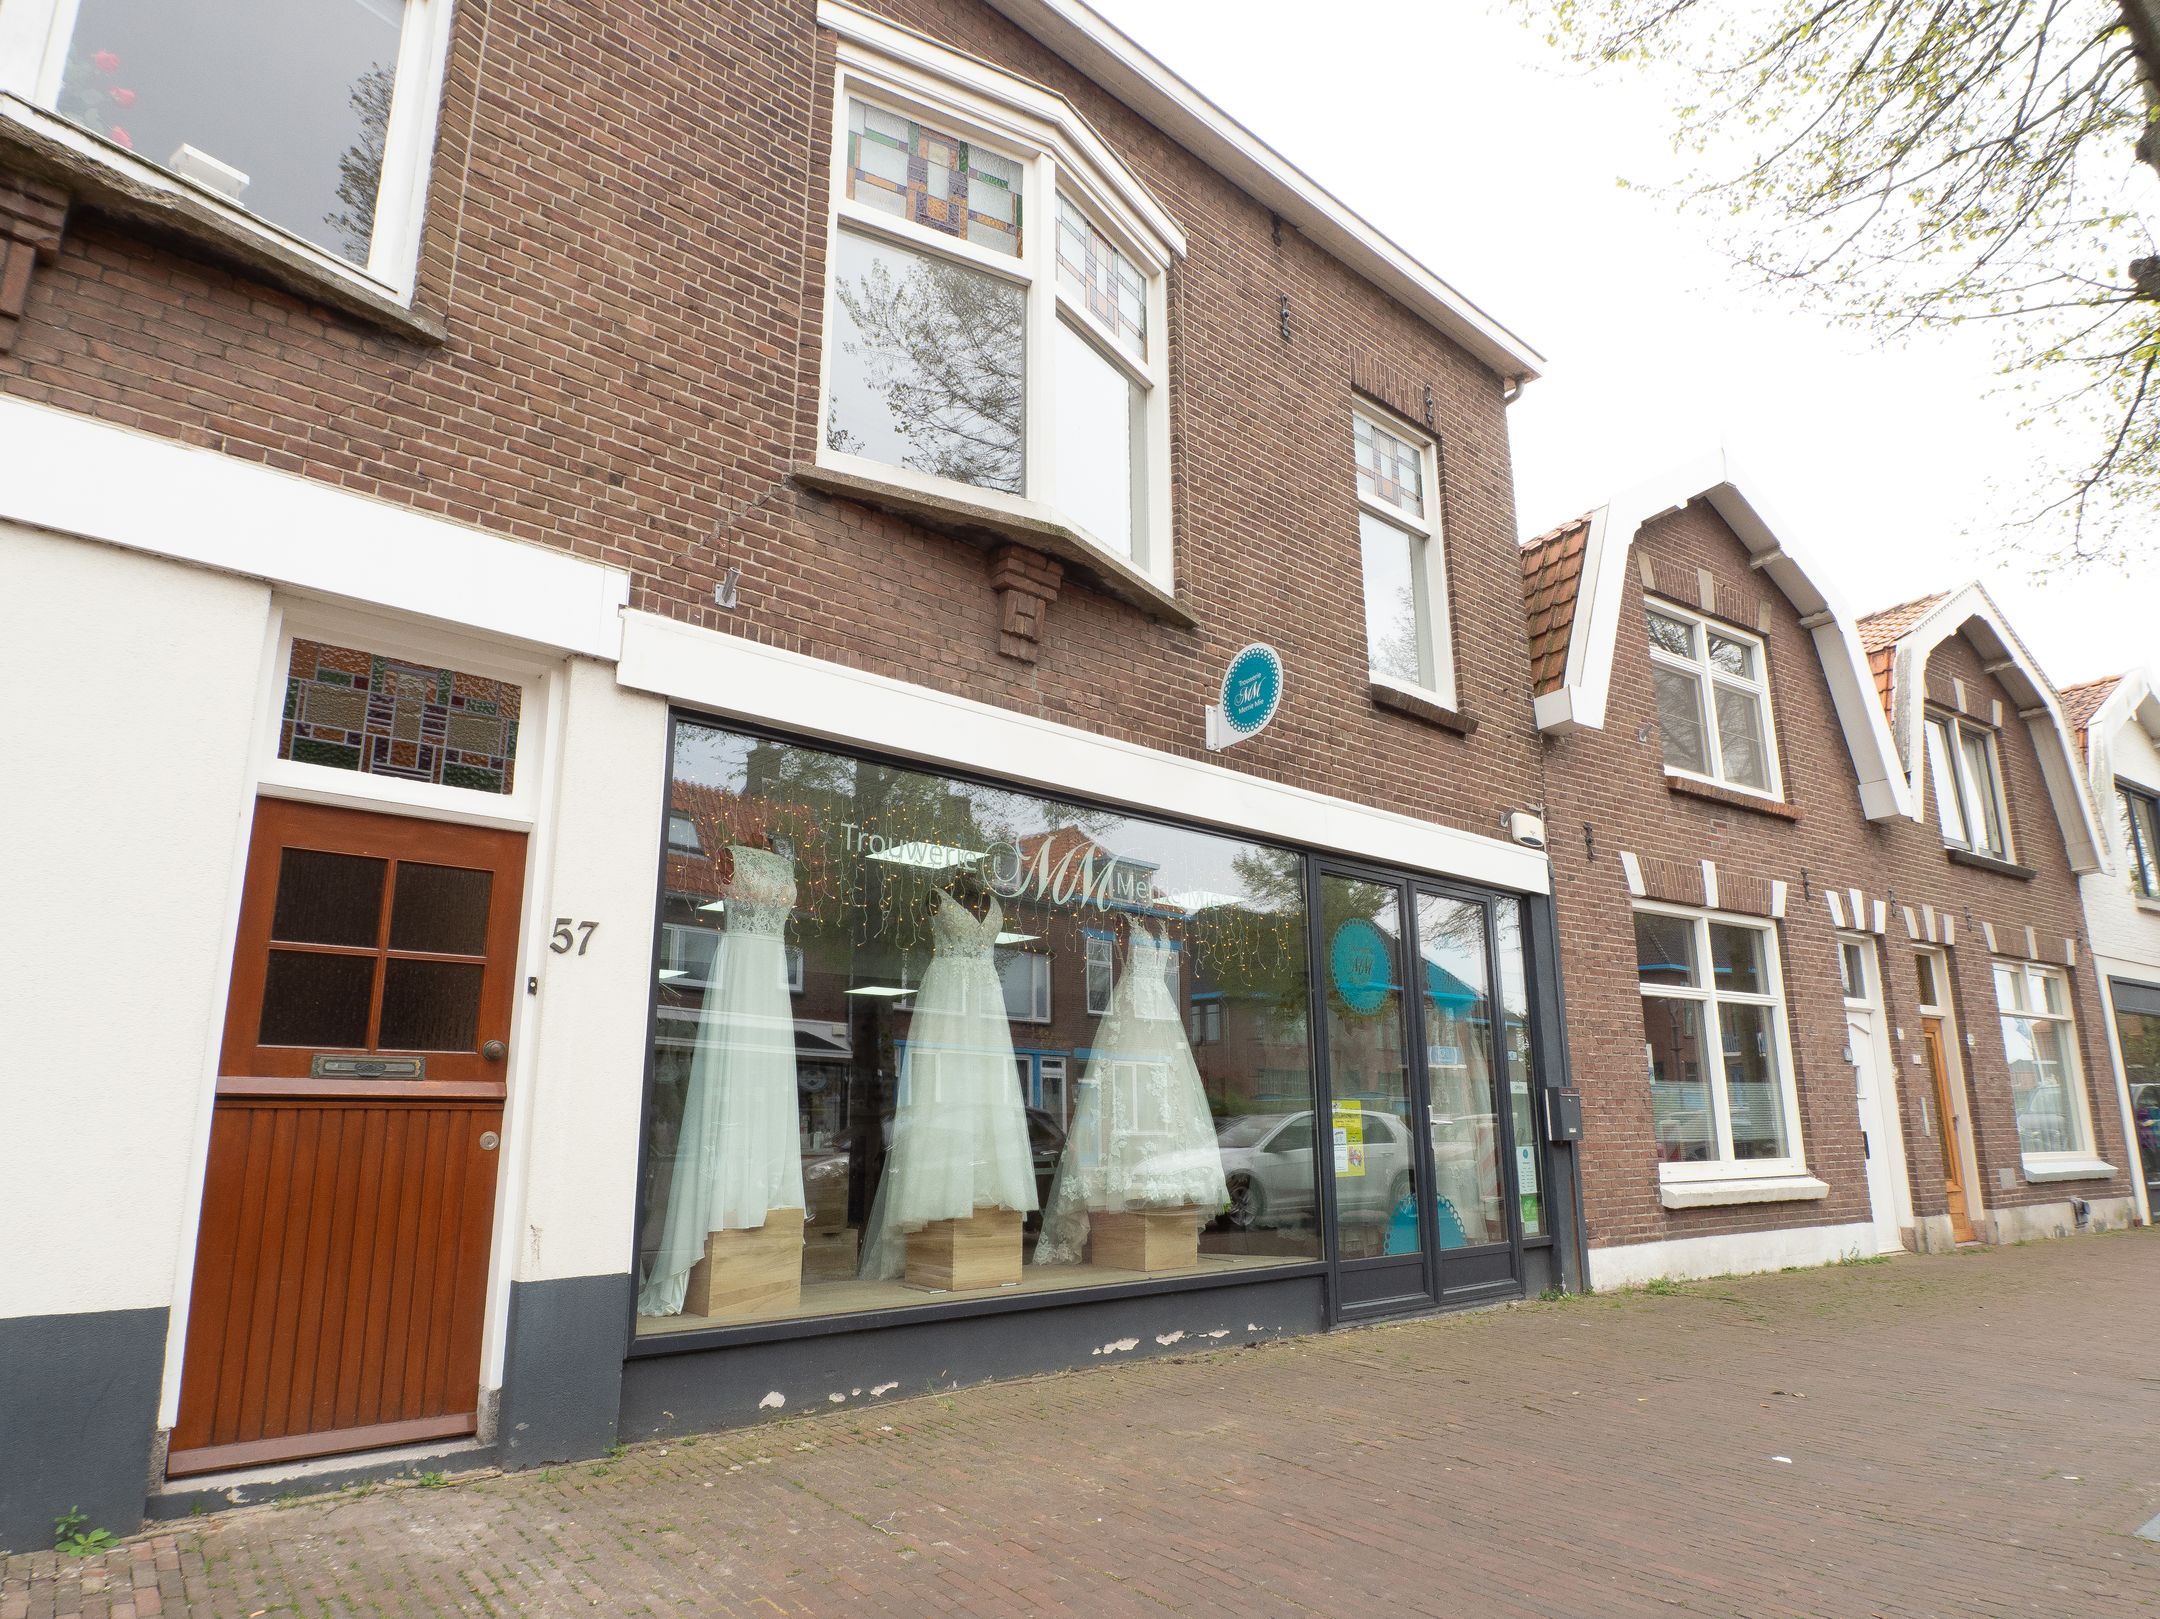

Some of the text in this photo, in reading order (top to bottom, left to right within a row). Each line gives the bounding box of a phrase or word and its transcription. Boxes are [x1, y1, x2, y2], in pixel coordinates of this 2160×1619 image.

[840, 821, 978, 873] Trouwerie
[982, 834, 1122, 913] MM
[549, 917, 600, 956] 57
